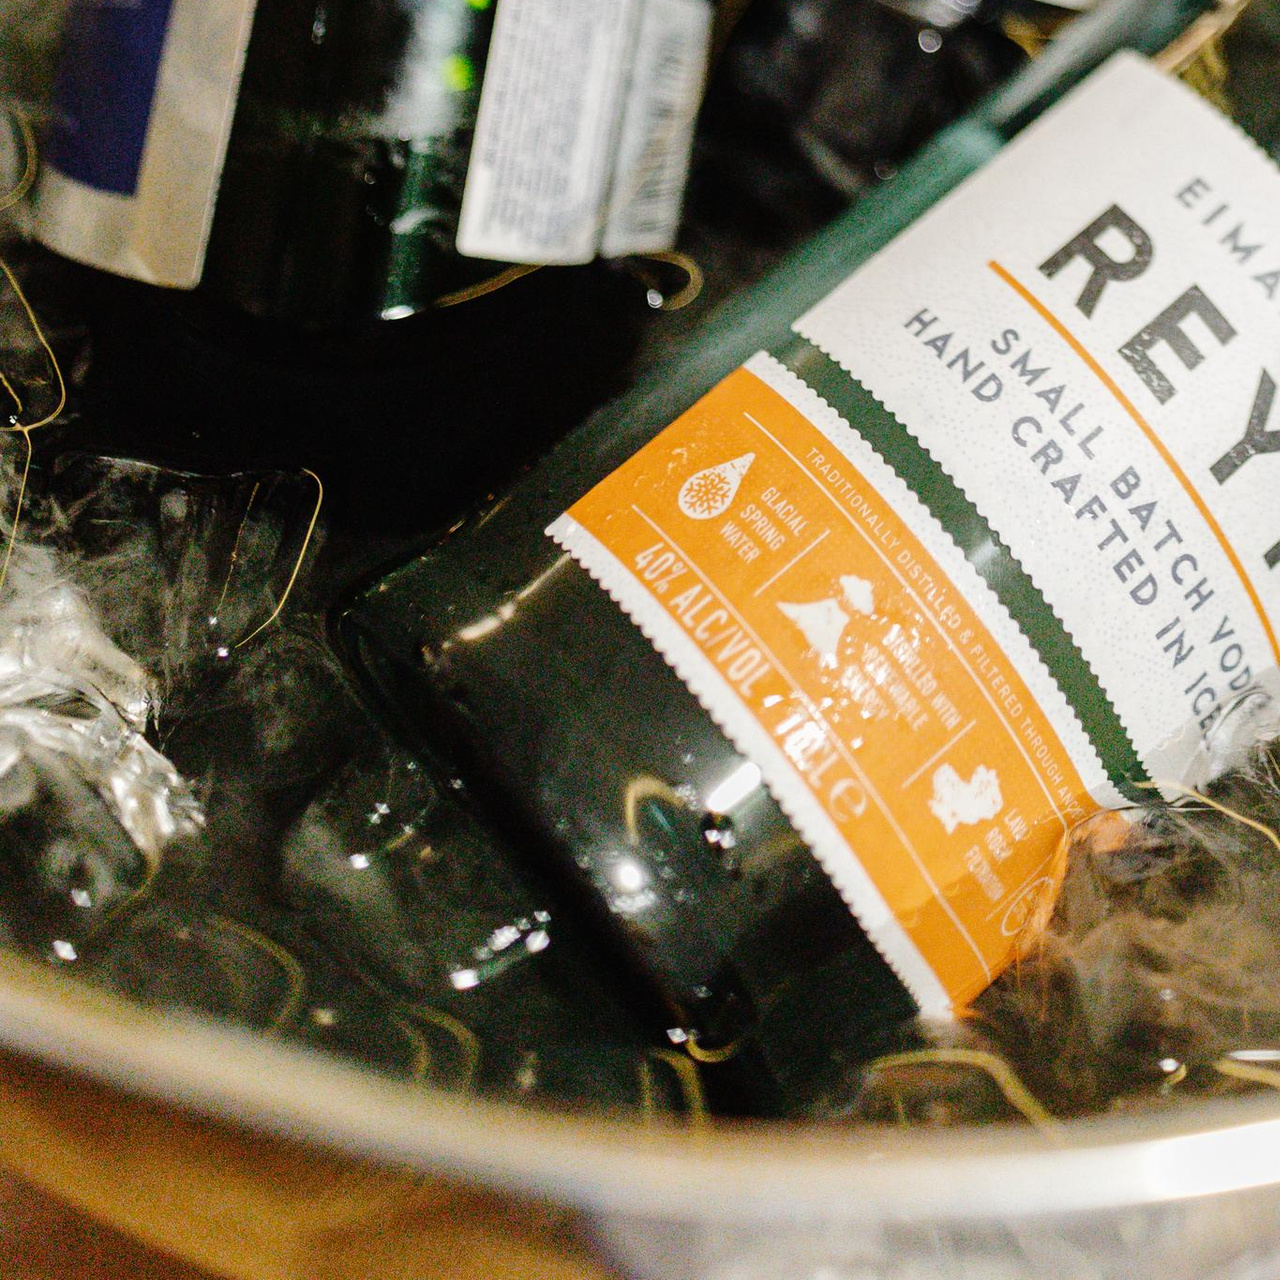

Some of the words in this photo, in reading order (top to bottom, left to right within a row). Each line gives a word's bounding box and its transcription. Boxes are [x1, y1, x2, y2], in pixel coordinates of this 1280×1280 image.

[740, 504, 785, 552] SPRING
[761, 486, 810, 537] GLACIAL
[904, 307, 1003, 403] HAND
[1011, 416, 1159, 607] CRAFTED
[1155, 616, 1195, 669] IN
[991, 328, 1104, 460] SMALL
[1110, 466, 1214, 613] BATCH
[1209, 615, 1256, 694] VOD
[720, 521, 762, 564] WATER
[635, 542, 688, 594] 40%
[670, 584, 772, 697] ALC/VOL
[805, 447, 899, 550] TRADITIONALLY
[898, 550, 961, 629] DISTILLED
[960, 630, 974, 645] &
[970, 645, 1023, 718] FILTERED
[1020, 717, 1063, 785] THROUGH
[931, 691, 961, 730] WITH
